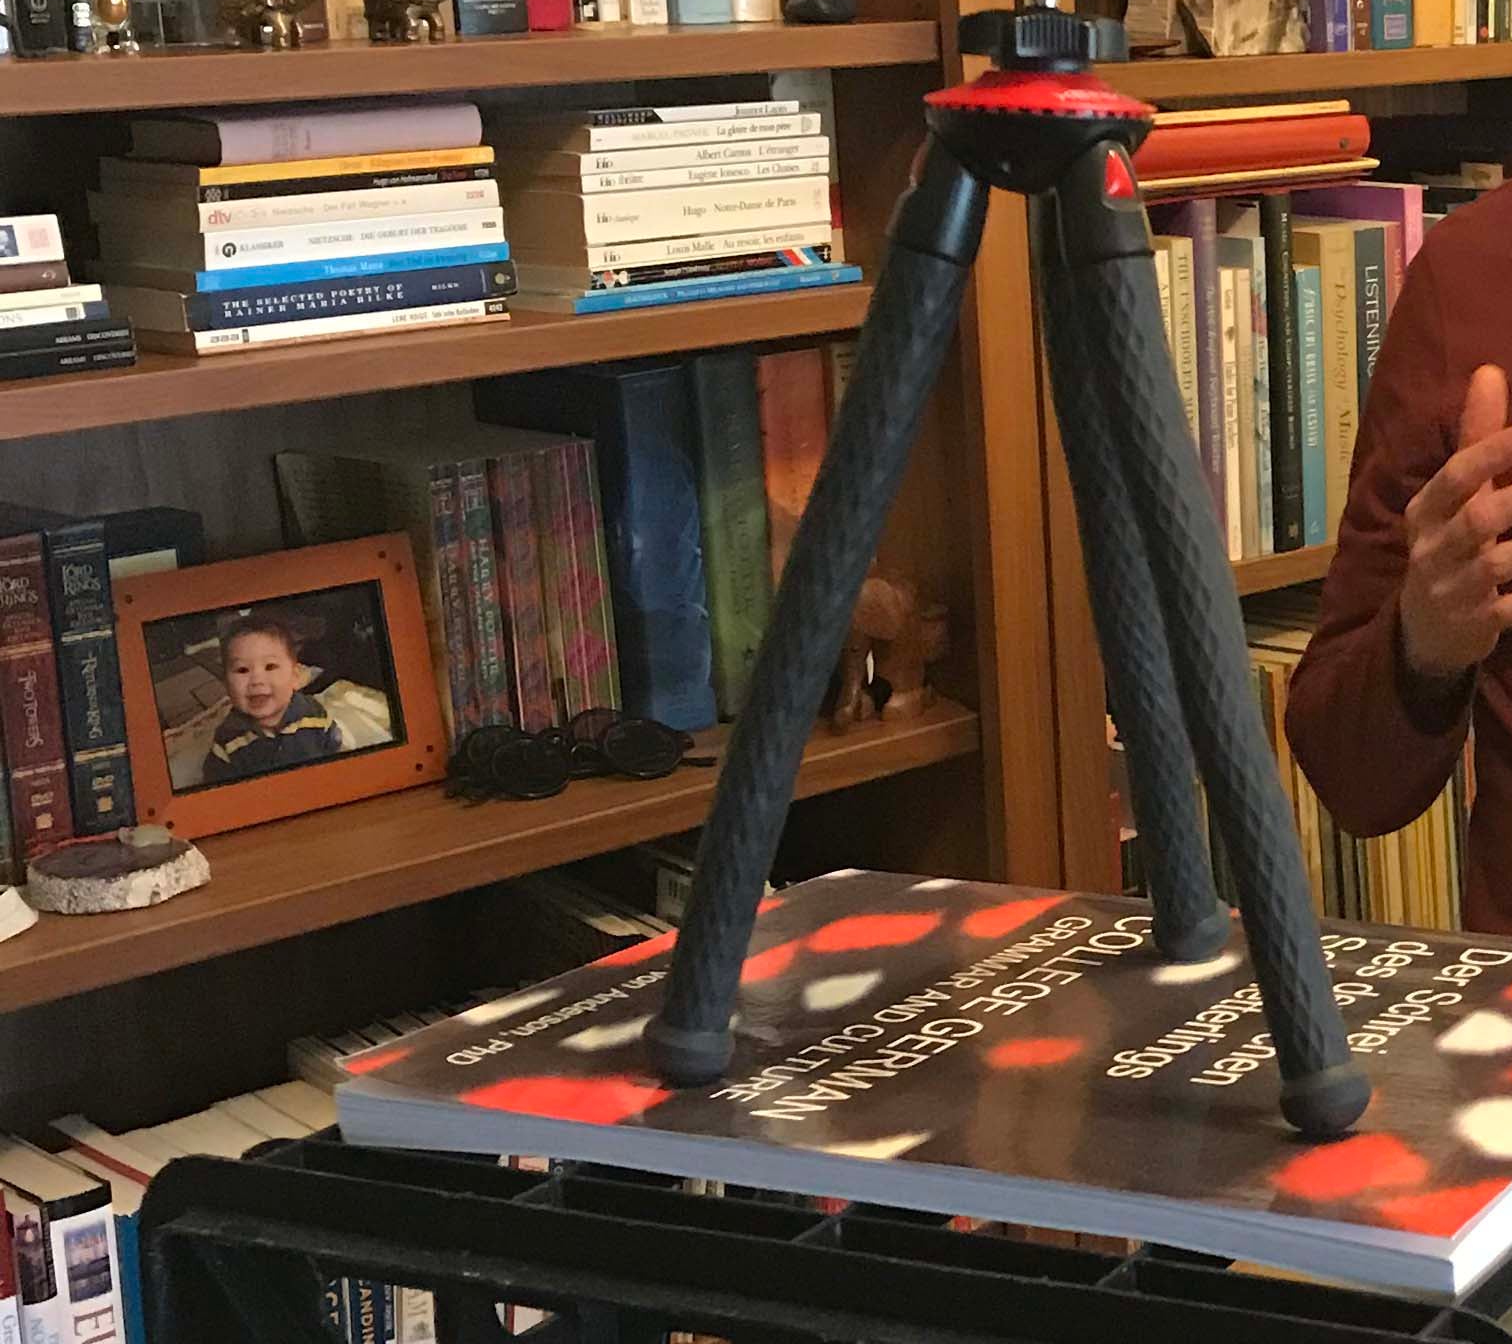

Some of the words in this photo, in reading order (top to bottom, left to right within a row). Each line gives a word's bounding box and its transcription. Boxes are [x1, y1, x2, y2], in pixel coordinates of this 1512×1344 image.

[695, 148, 721, 160] Albert
[722, 147, 751, 158] Camus
[719, 166, 751, 178] Ionesco
[757, 164, 770, 175] Les
[207, 209, 232, 225] dtv
[682, 205, 706, 218] Hugo
[713, 201, 763, 214] Notre-Dame
[764, 199, 775, 209] de
[775, 197, 797, 208] Paris
[239, 240, 284, 253] KLASSIKER
[308, 233, 353, 246] NIETZSCHE
[666, 244, 690, 255] Louis
[691, 241, 715, 253] Malle
[722, 239, 735, 249] Au
[762, 235, 773, 245] les
[774, 232, 805, 244] enfants
[324, 261, 357, 275] Thomas
[359, 259, 384, 271] Mann
[223, 298, 249, 310] THE
[255, 291, 325, 307] SELECTED
[330, 285, 381, 299] POETRY
[387, 282, 404, 293] OF
[223, 304, 287, 319] RAINER
[296, 297, 349, 311] MARIA
[356, 291, 405, 304] RILKE
[1333, 282, 1350, 391] Psychology
[478, 538, 493, 604] HARRY
[485, 609, 499, 675] POTTER
[935, 916, 1093, 990] GRAMMAR
[959, 914, 1154, 1016] COLLEGE
[1357, 940, 1434, 981] des
[621, 971, 668, 990] von
[499, 988, 630, 1039] Anderson,
[872, 988, 952, 1024] AND
[1346, 988, 1463, 1055] Schrei
[446, 1038, 515, 1066] PhD
[708, 1023, 885, 1103] CULTURE
[749, 1017, 984, 1122] GERMAN
